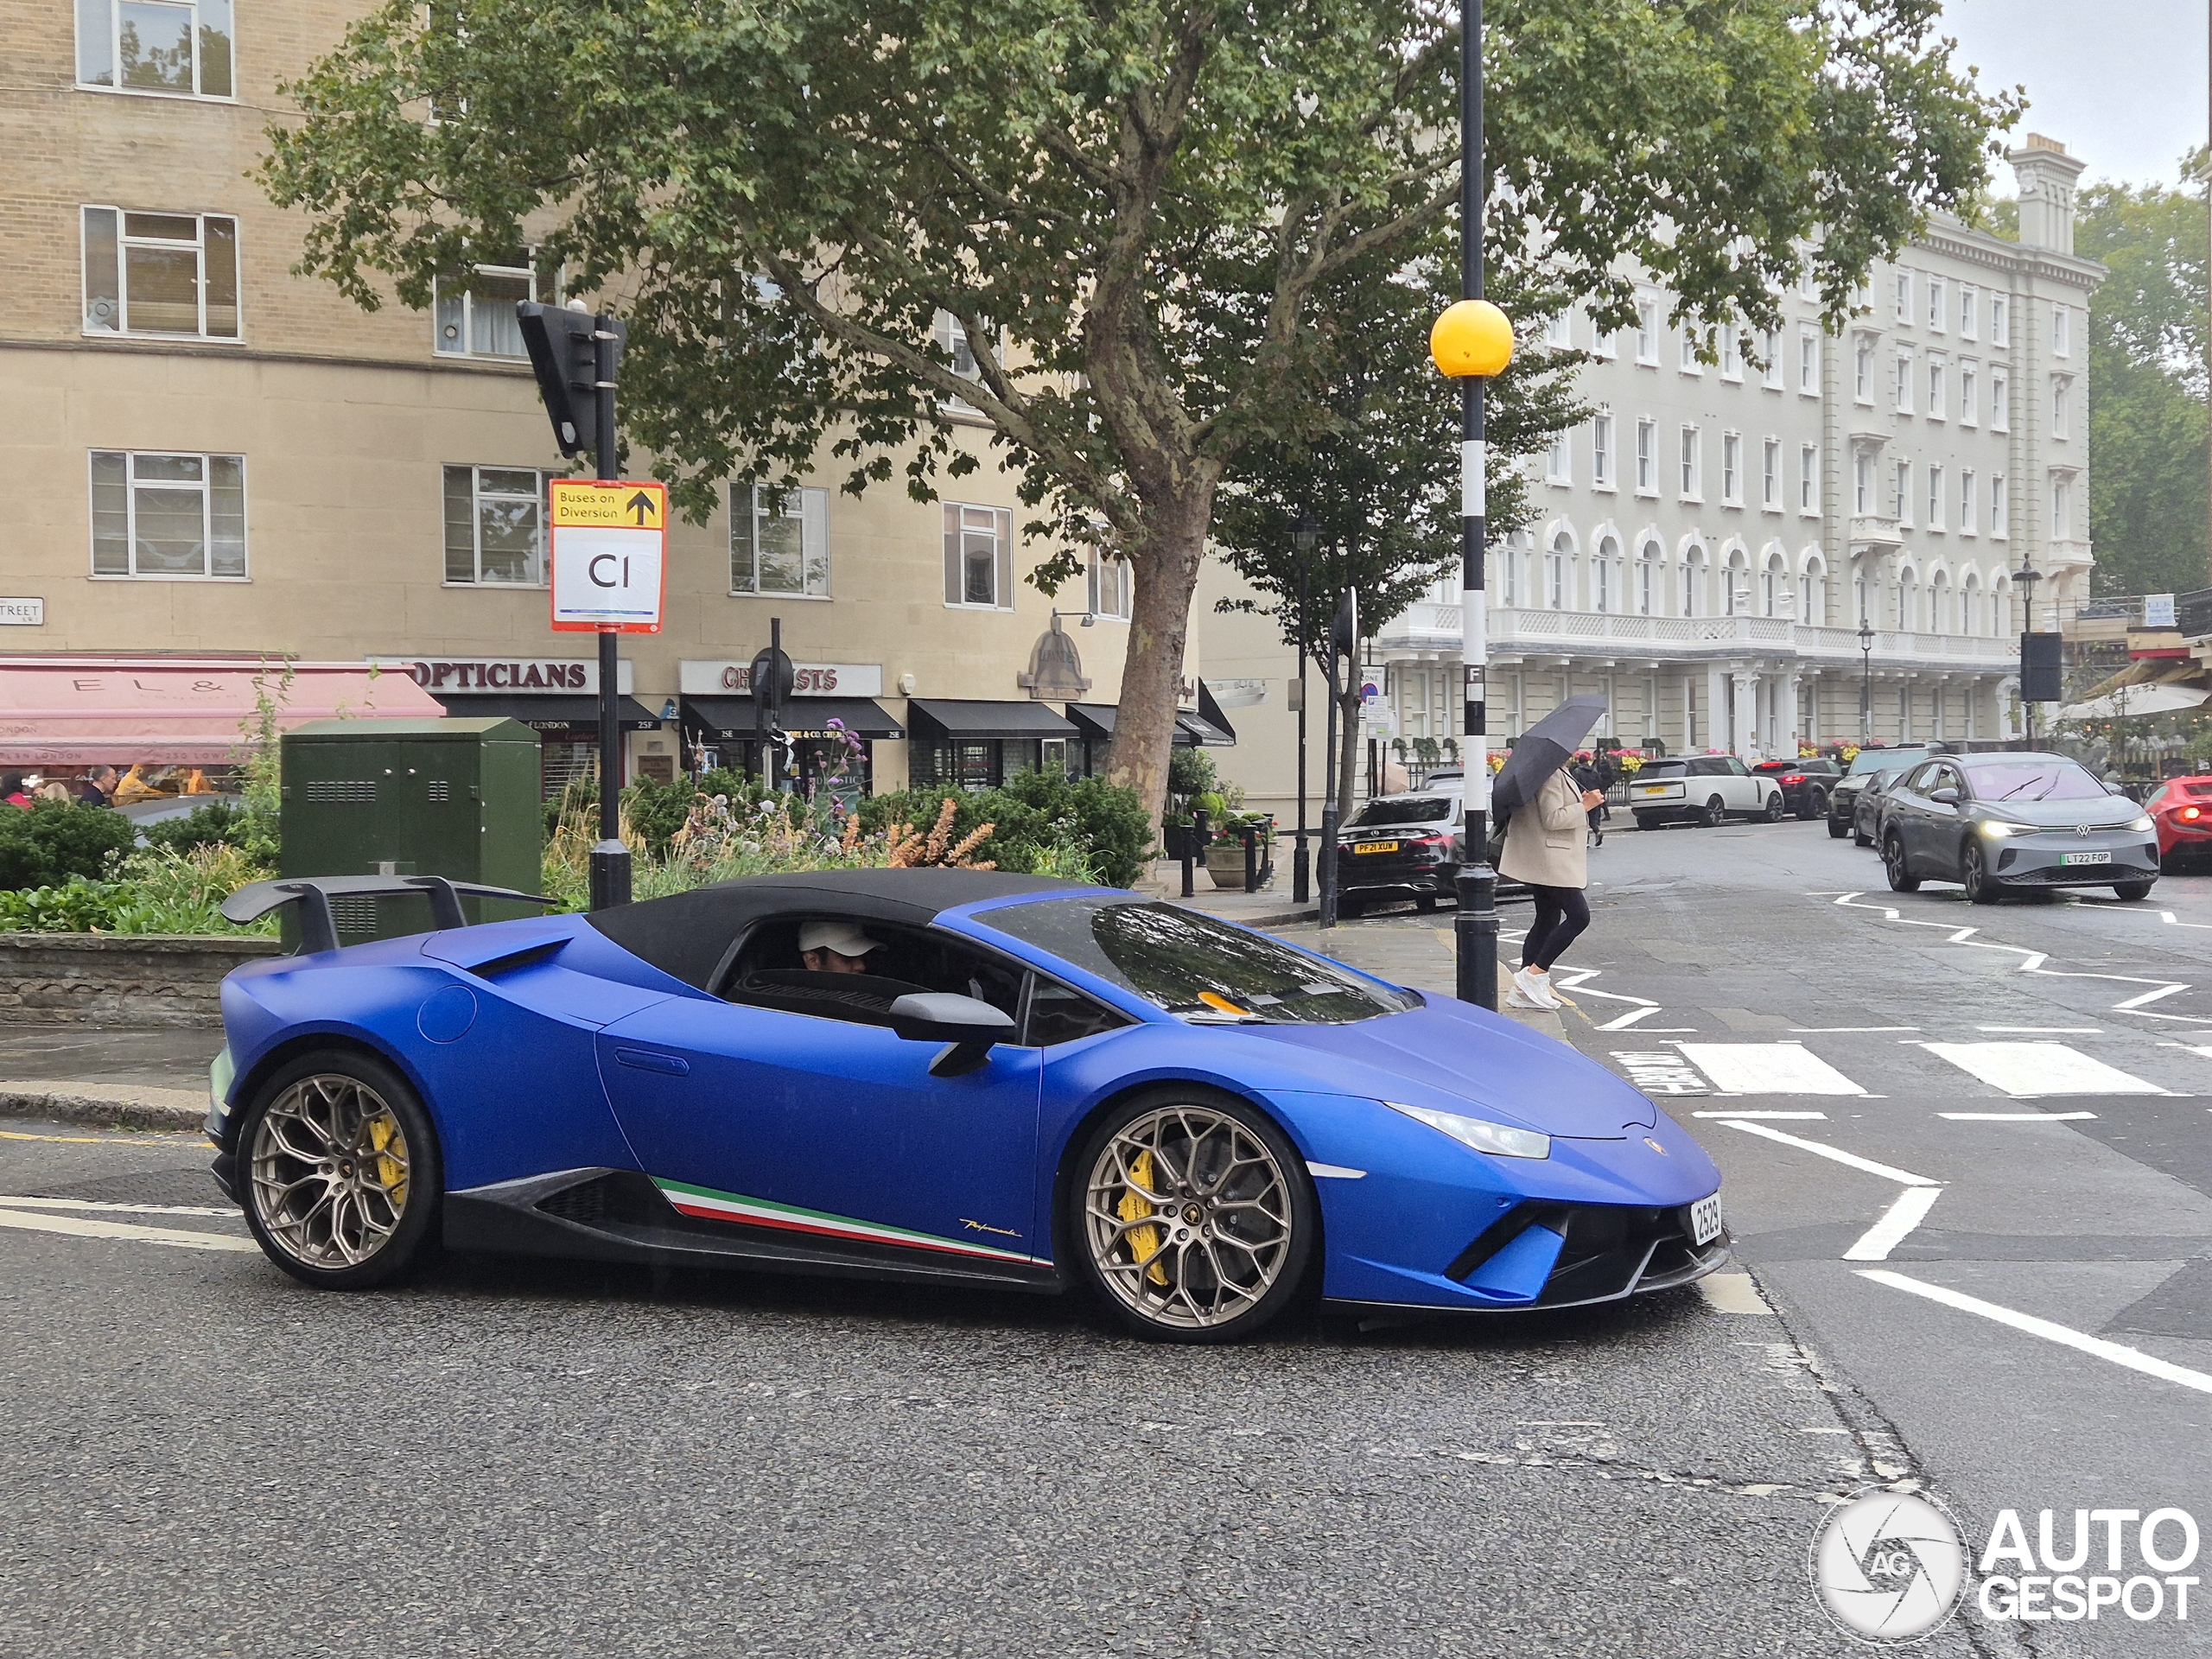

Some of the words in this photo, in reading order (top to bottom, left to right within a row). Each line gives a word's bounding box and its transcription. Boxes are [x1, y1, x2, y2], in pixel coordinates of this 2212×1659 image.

[561, 492, 596, 503] Buses
[600, 495, 615, 504] on
[561, 506, 618, 518] Diversion
[412, 662, 587, 689] OPTICIANS
[722, 666, 838, 690] CHSTS
[1470, 668, 1481, 682] F
[534, 721, 570, 729] LONDON
[638, 721, 653, 729] 25F
[1359, 843, 1376, 852] PF21
[2066, 854, 2090, 863] LT22
[2092, 853, 2109, 862] FOP
[1696, 1199, 1719, 1240] 2529
